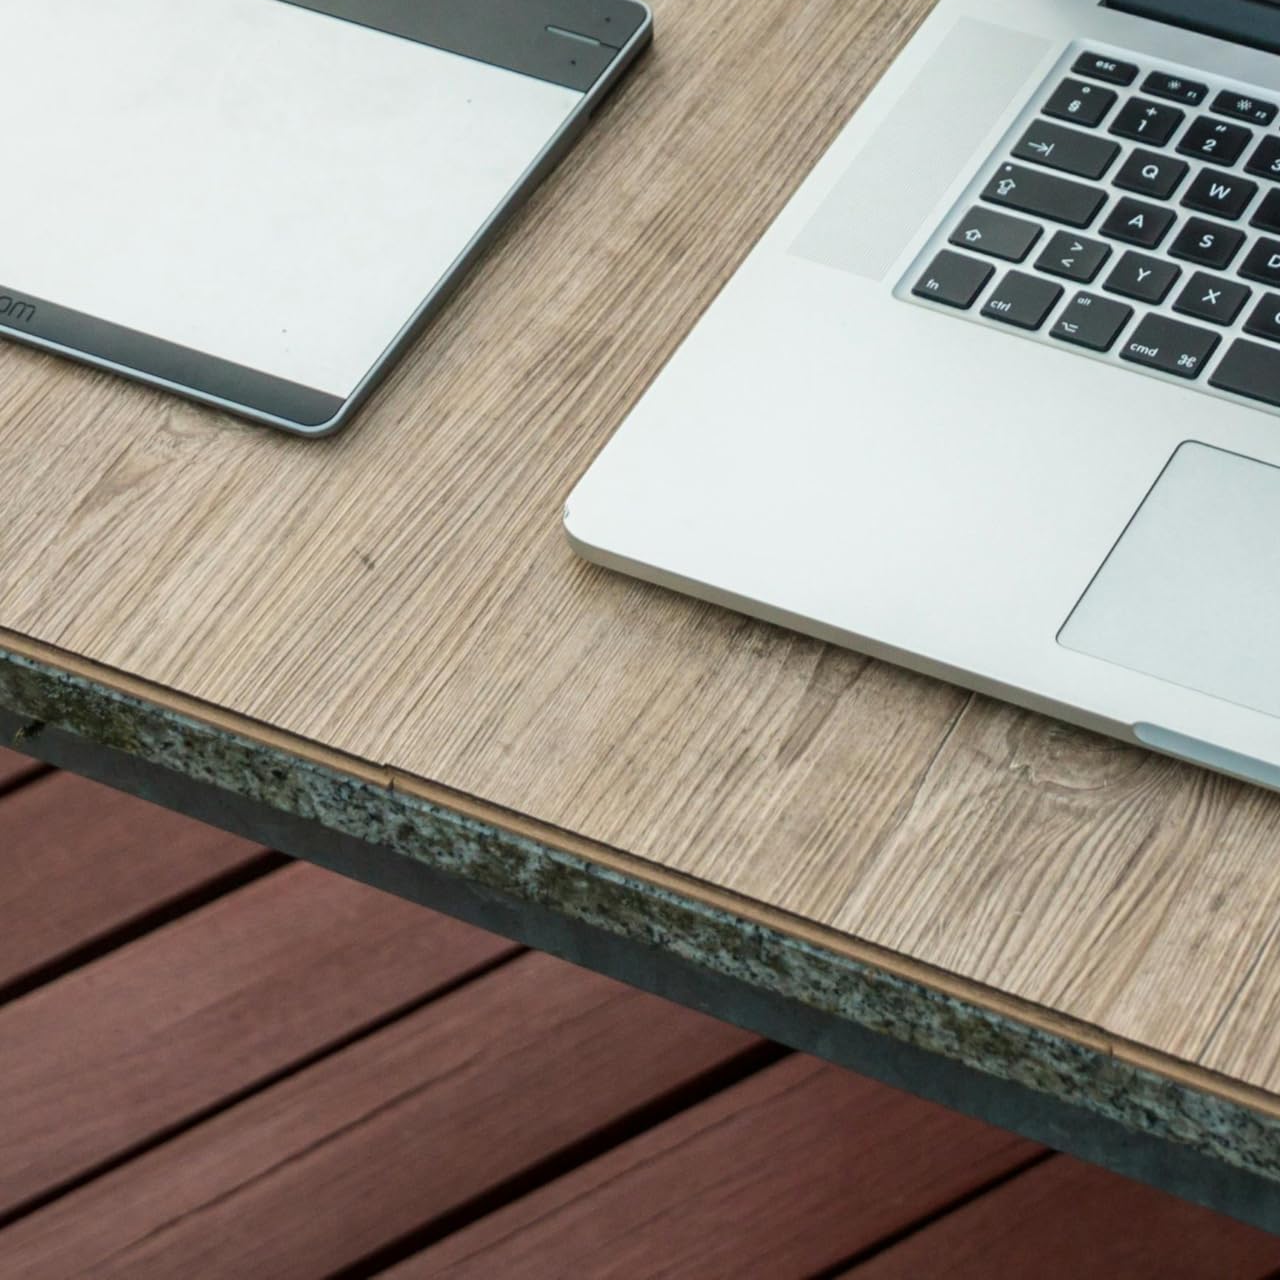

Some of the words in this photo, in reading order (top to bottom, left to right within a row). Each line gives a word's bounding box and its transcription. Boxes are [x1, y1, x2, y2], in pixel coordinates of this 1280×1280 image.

[1095, 58, 1119, 71] esc
[1139, 120, 1146, 131] 1
[1203, 139, 1216, 151] 2
[1142, 165, 1158, 179] Q
[1210, 184, 1230, 199] W
[1128, 215, 1143, 227] A
[1200, 235, 1214, 247] S
[1138, 268, 1151, 281] Y
[927, 279, 938, 289] fn
[1077, 296, 1092, 306] alt
[1202, 289, 1220, 304] X
[990, 299, 1012, 312] ctrl
[1130, 344, 1158, 356] cmd
